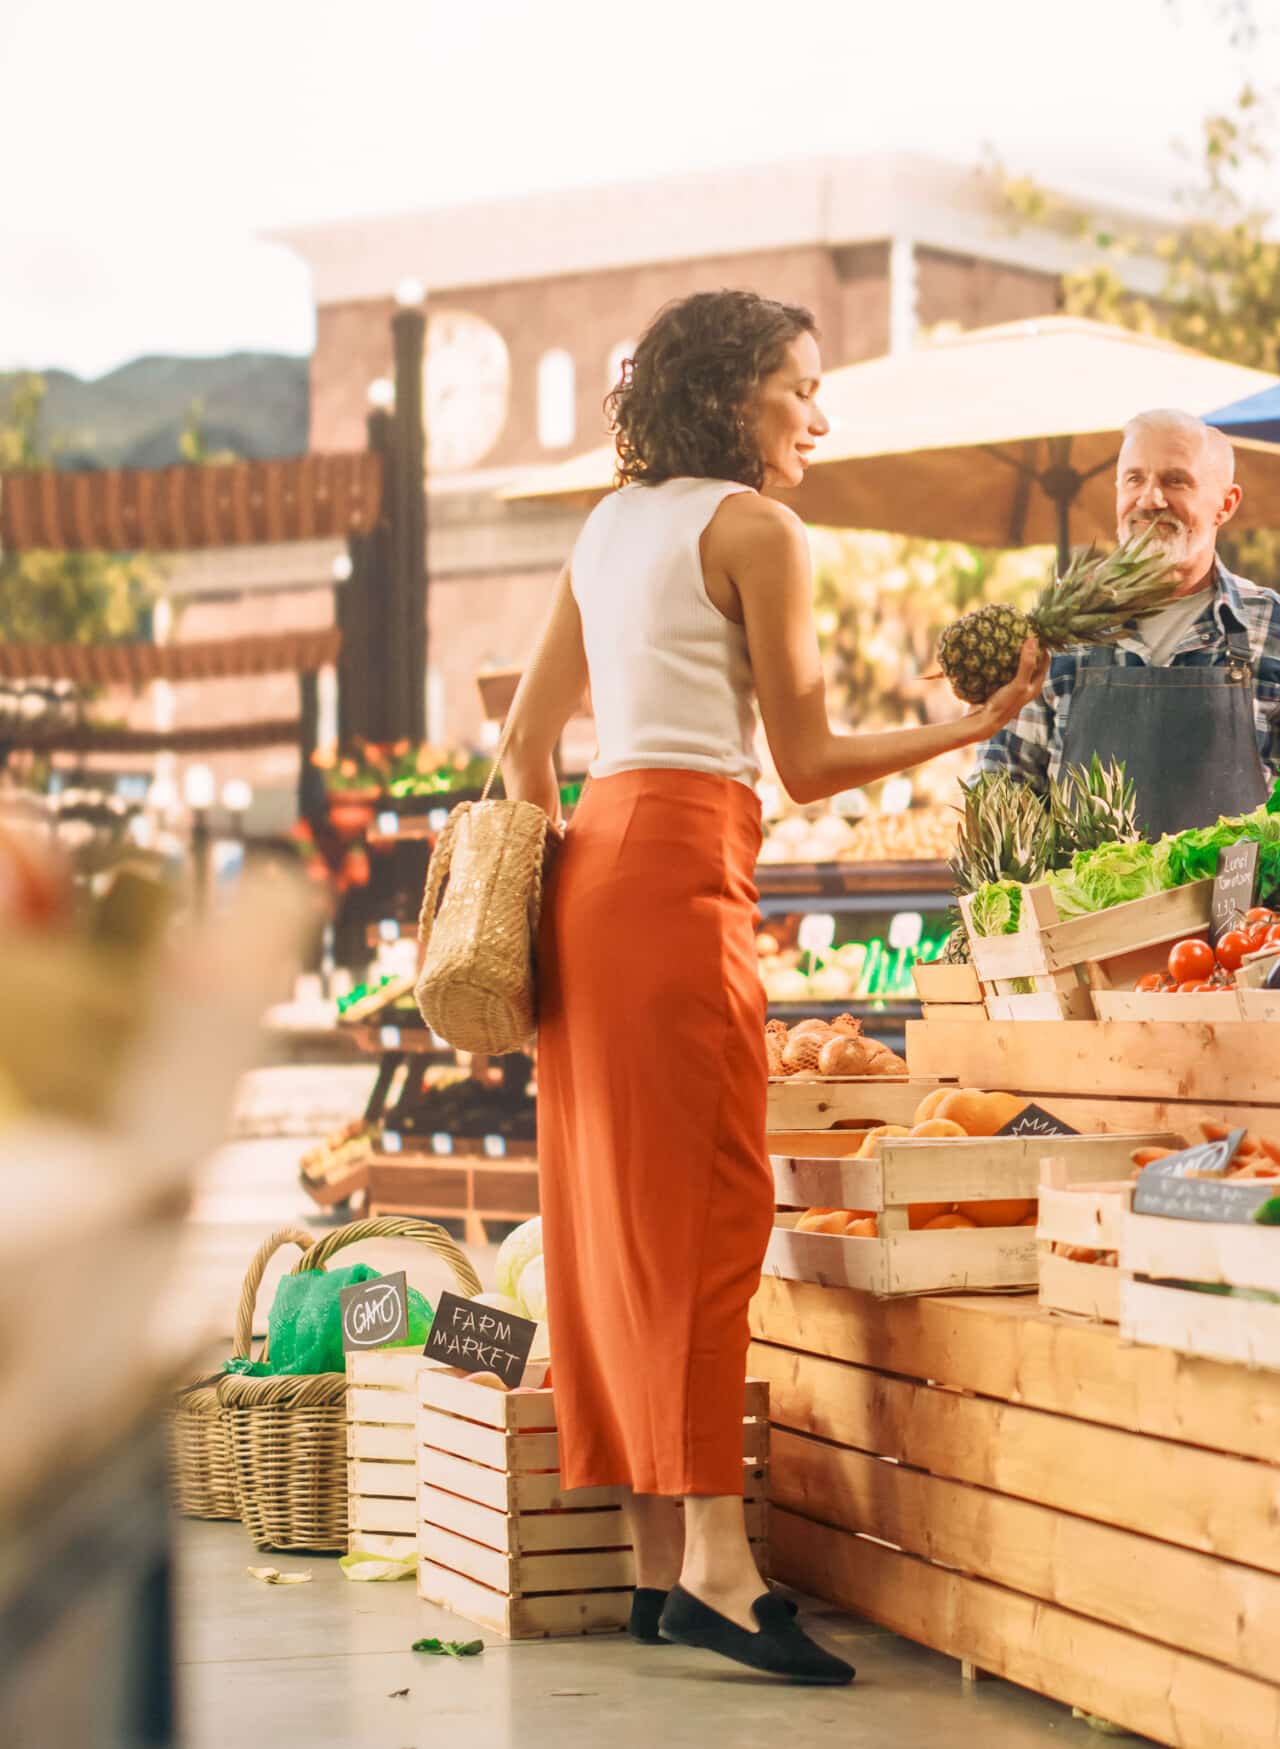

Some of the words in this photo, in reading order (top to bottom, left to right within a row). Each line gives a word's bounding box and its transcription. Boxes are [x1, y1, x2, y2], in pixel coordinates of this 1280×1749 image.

[353, 1298, 395, 1334] GMO
[452, 1306, 512, 1341] FARM
[433, 1330, 521, 1375] MARKET
